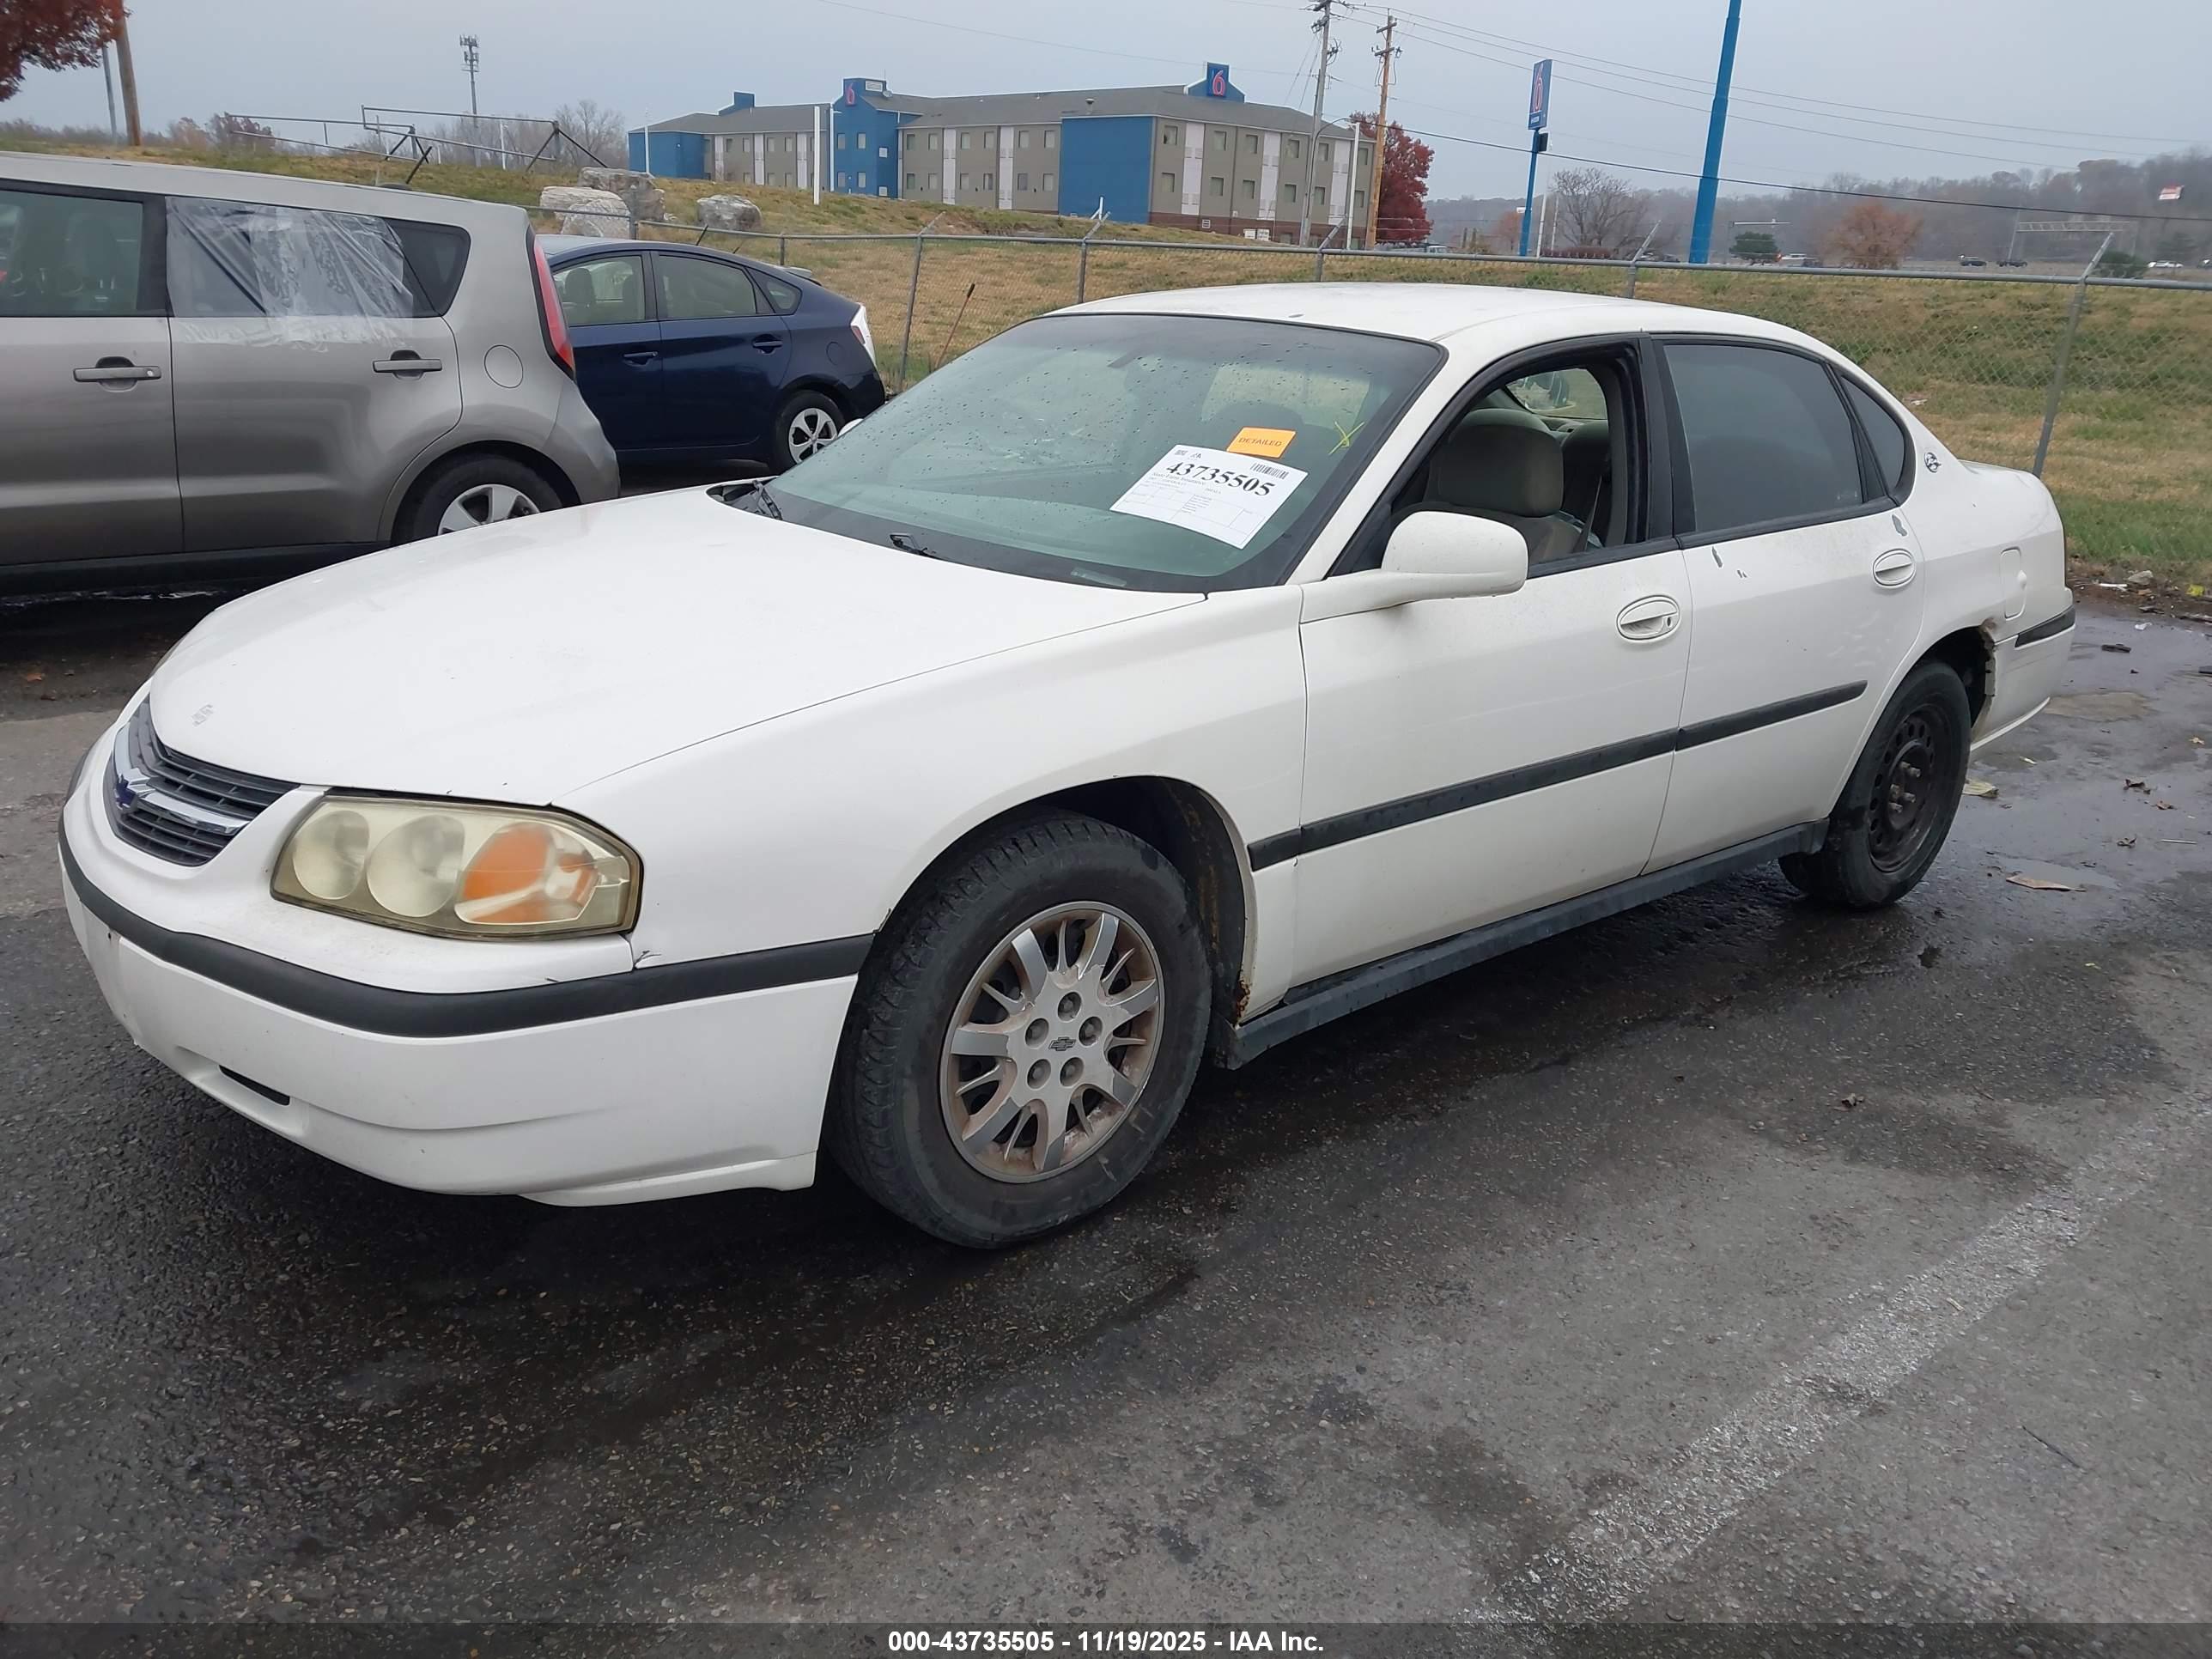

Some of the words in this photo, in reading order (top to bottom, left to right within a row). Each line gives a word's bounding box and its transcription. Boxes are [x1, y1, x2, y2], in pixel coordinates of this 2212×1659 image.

[847, 82, 855, 105] 6
[1212, 70, 1225, 96] 6
[1533, 63, 1543, 112] 6
[1238, 438, 1283, 447] DETAILED
[1166, 462, 1275, 496] 43735505
